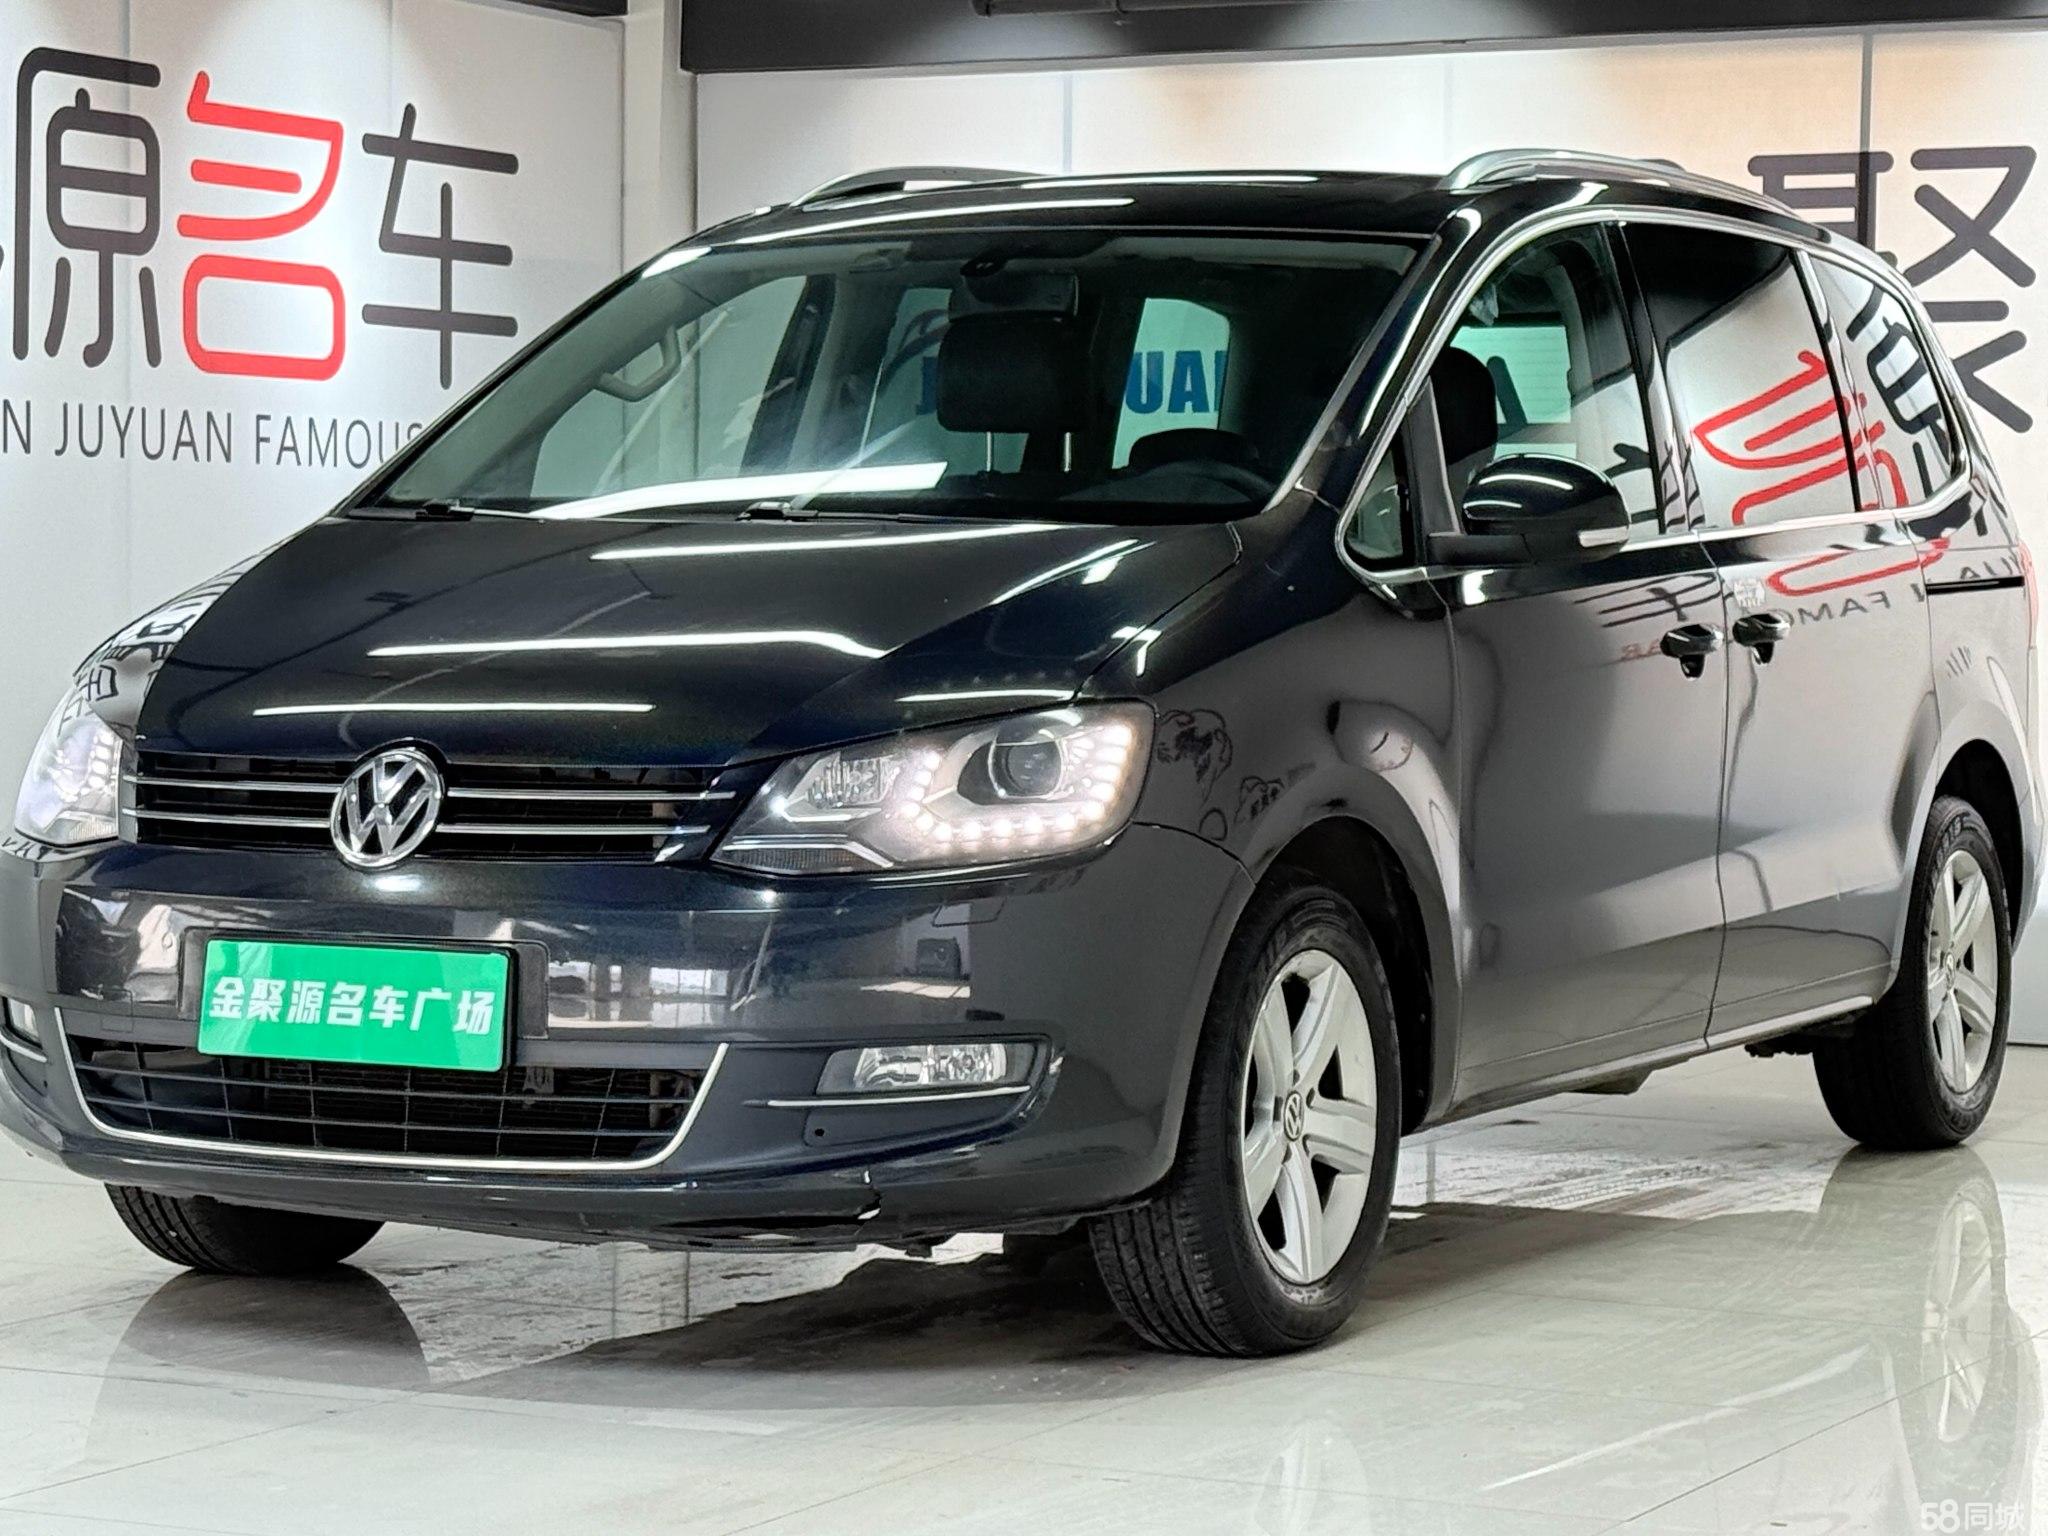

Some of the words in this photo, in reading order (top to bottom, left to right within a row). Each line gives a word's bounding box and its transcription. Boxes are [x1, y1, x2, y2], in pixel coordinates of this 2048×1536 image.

[54, 402, 233, 464] JUYUAN
[208, 976, 495, 1035] 金聚源名车广场
